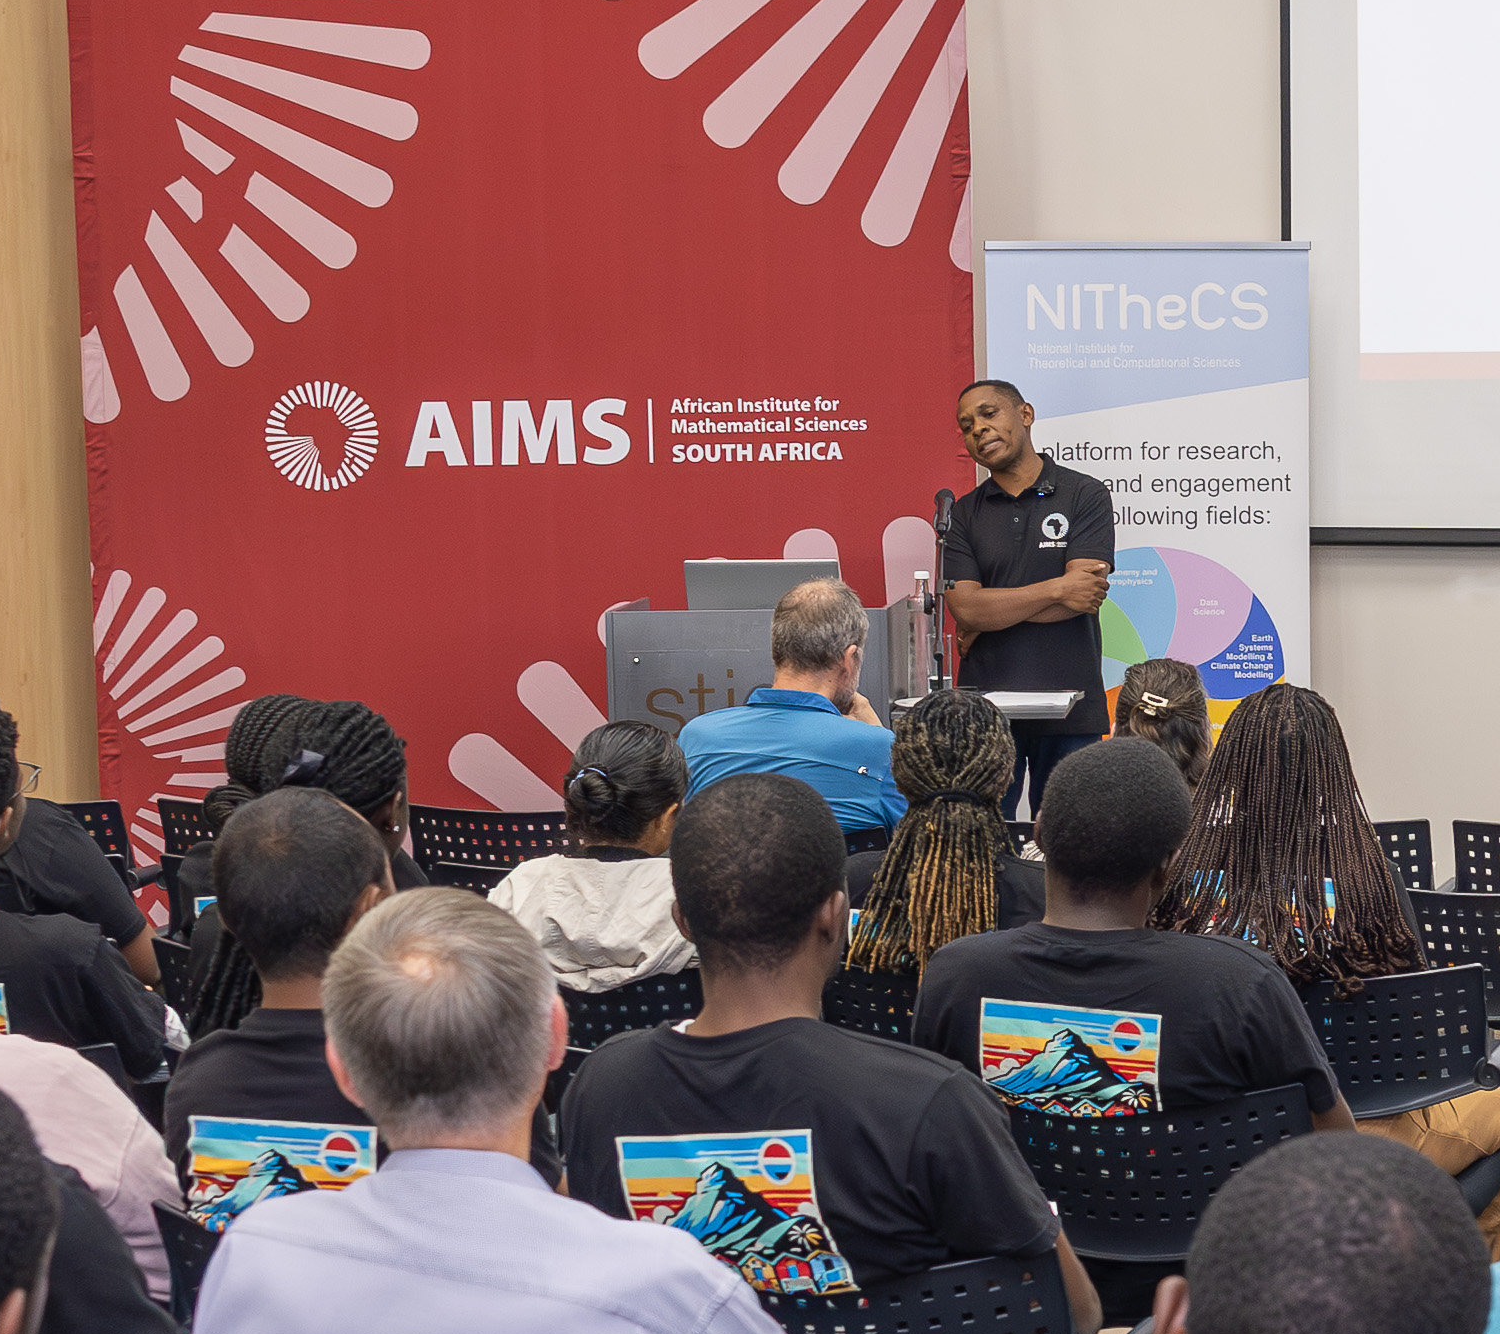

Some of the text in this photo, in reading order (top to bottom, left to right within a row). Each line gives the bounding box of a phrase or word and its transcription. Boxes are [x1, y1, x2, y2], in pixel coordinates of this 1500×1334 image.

[1026, 282, 1269, 331] NITheCS
[1027, 342, 1135, 355] National Institute for
[1027, 356, 1241, 370] Theoretical and Computational Sciences
[670, 395, 840, 414] African Institute for
[404, 398, 631, 467] AIMS
[671, 416, 868, 434] Mathematical Sciences
[672, 441, 844, 463] SOUTH AFRICA
[1140, 441, 1171, 461] for
[1177, 440, 1283, 463] research,
[1102, 473, 1293, 498] and engagement
[1112, 505, 1272, 530] ollowing fields:
[1199, 598, 1219, 607] Data
[1192, 607, 1226, 616] Science
[1251, 634, 1274, 642] Earth
[1238, 643, 1274, 652] Systems
[1225, 652, 1274, 662] Modelling &
[1210, 662, 1274, 671] Climate Change
[1233, 671, 1274, 680] Modelling
[646, 668, 773, 737] sti
